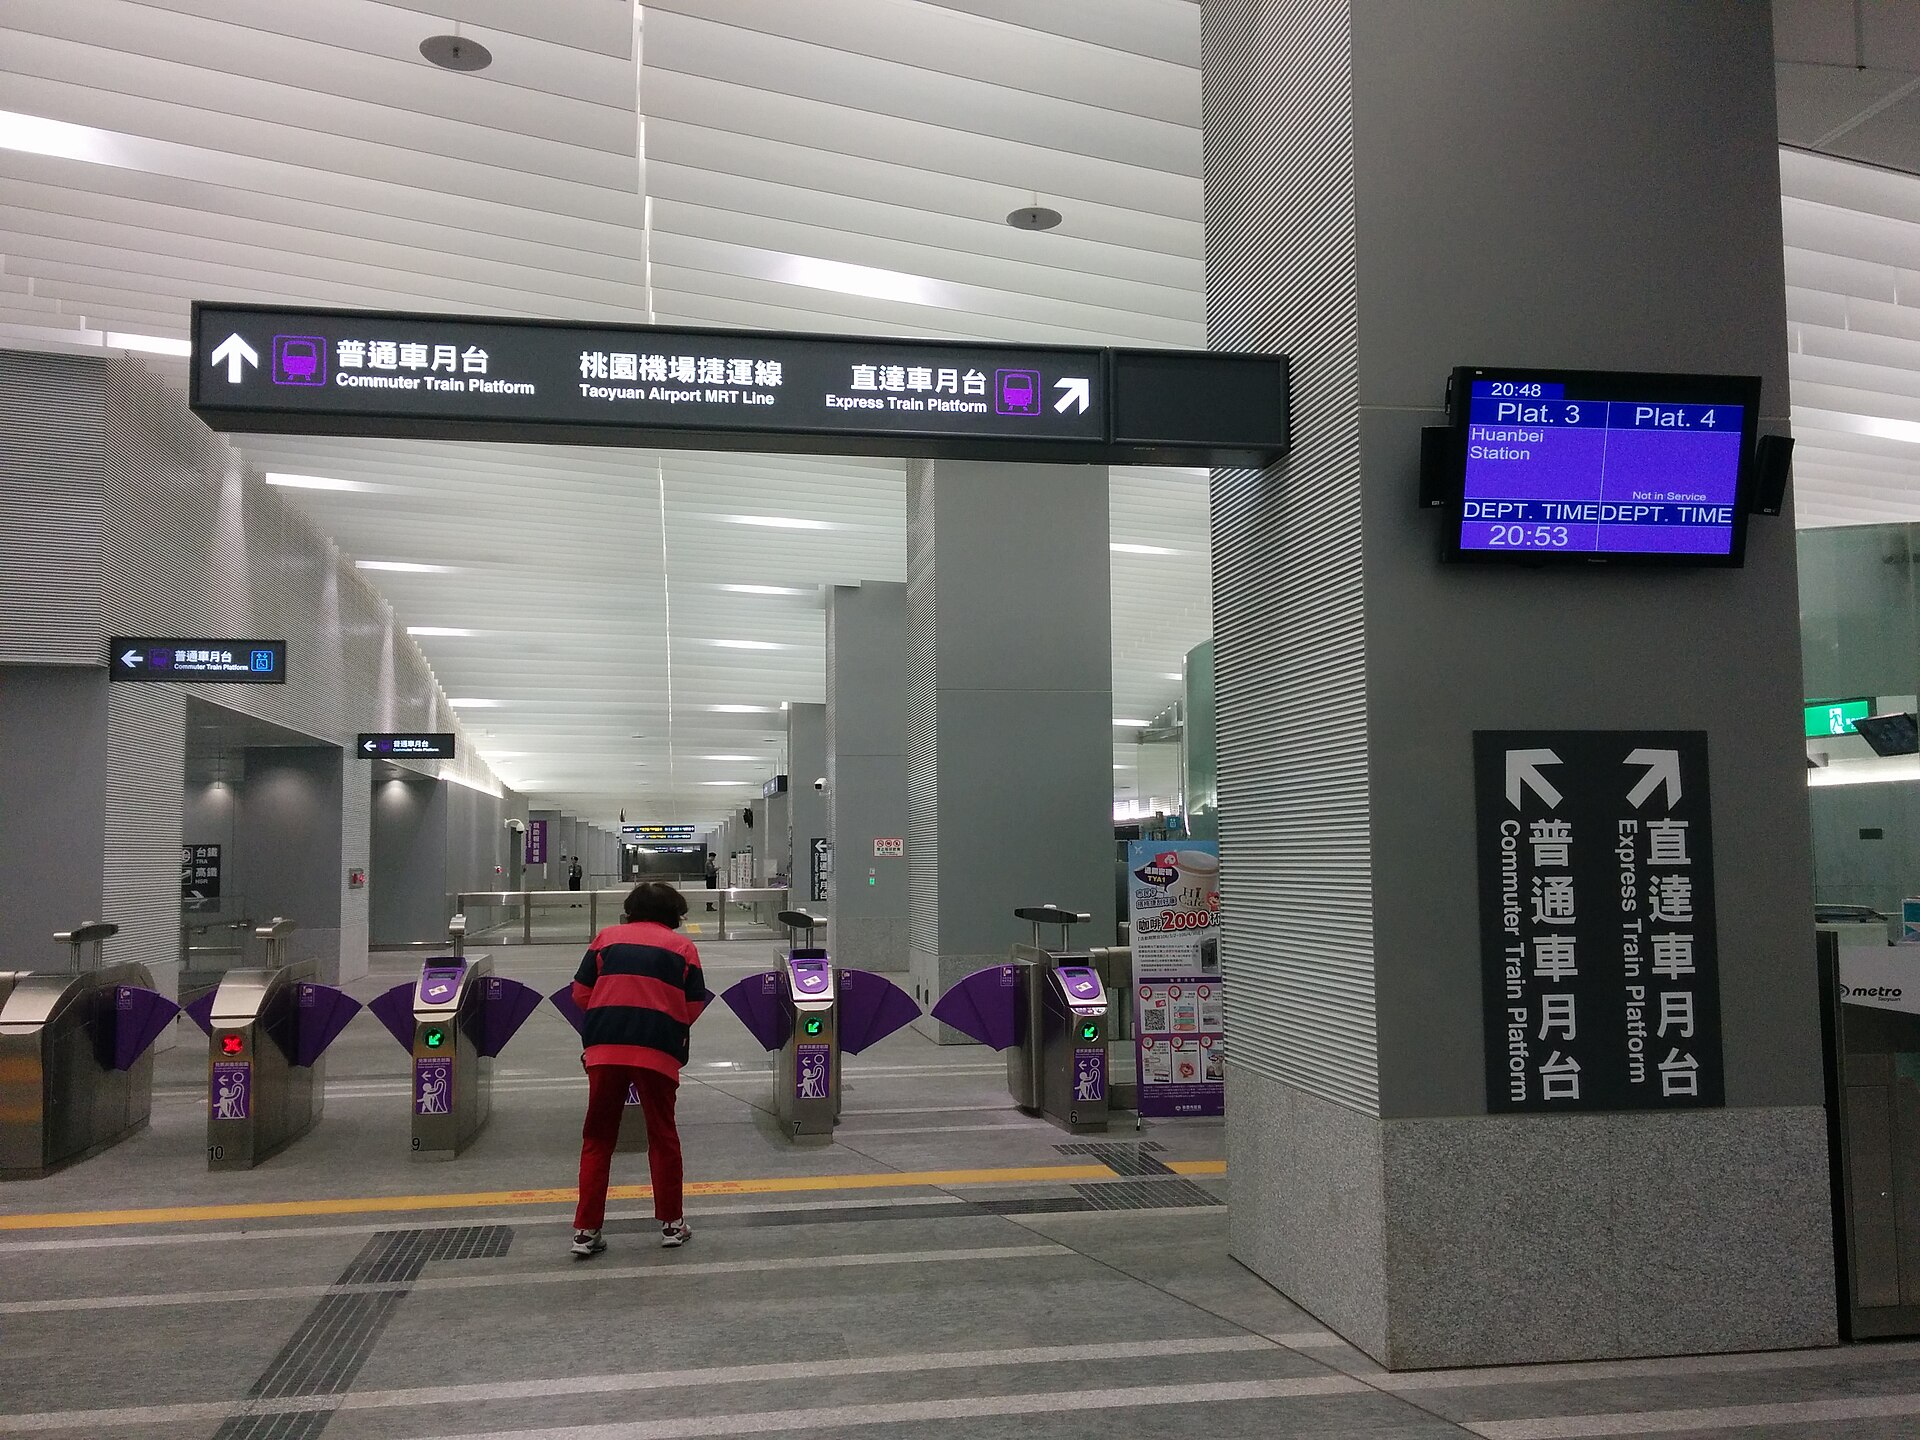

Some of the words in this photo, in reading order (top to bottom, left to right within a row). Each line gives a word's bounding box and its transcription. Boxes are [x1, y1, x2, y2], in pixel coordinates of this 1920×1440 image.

[336, 339, 489, 374] 普通車月台
[578, 351, 783, 387] 桃園機場捷運線
[850, 363, 987, 395] 直達車月台
[335, 372, 418, 390] Commuter
[423, 377, 463, 393] Train
[468, 379, 536, 396] Platform
[1491, 382, 1541, 398] 20:48
[578, 384, 645, 402] Taoyuan
[649, 386, 702, 405] Airport
[705, 389, 739, 404] MRT
[743, 390, 776, 406] Line
[825, 394, 884, 410] Express
[887, 396, 924, 410] Train
[927, 398, 987, 412] Platform
[1497, 402, 1555, 424] Plat.
[1564, 404, 1580, 424] 3
[1635, 406, 1691, 428] Plat.
[1700, 409, 1716, 428] 4
[1471, 427, 1544, 443] Huanbei
[1470, 445, 1530, 460] Station
[1632, 491, 1653, 501] Not
[1657, 491, 1664, 501] in
[1667, 492, 1707, 502] Service
[1463, 501, 1534, 520] DEPT.
[1543, 503, 1598, 520] TIME
[1601, 505, 1669, 522] DEPT.
[1677, 507, 1733, 524] TIME
[1488, 524, 1569, 547] 20:53
[174, 650, 232, 663] 普通車月台
[196, 847, 218, 858] 台鐵
[195, 867, 218, 878] 高鐵
[1614, 819, 1638, 912] Express
[1147, 875, 1166, 883] TYA1
[1499, 819, 1520, 936] Commuter
[1622, 918, 1642, 977] Train
[1645, 817, 1700, 1098] 直達車月台
[1528, 818, 1582, 1102] 普通車月台
[1504, 942, 1525, 999] Train
[1852, 986, 1902, 997] metro
[1624, 985, 1646, 1084] Platform
[1507, 1007, 1528, 1102] Platform
[1070, 1110, 1078, 1125] 6
[794, 1121, 802, 1135] 7
[207, 1145, 224, 1161] 10
[411, 1137, 421, 1151] 9
